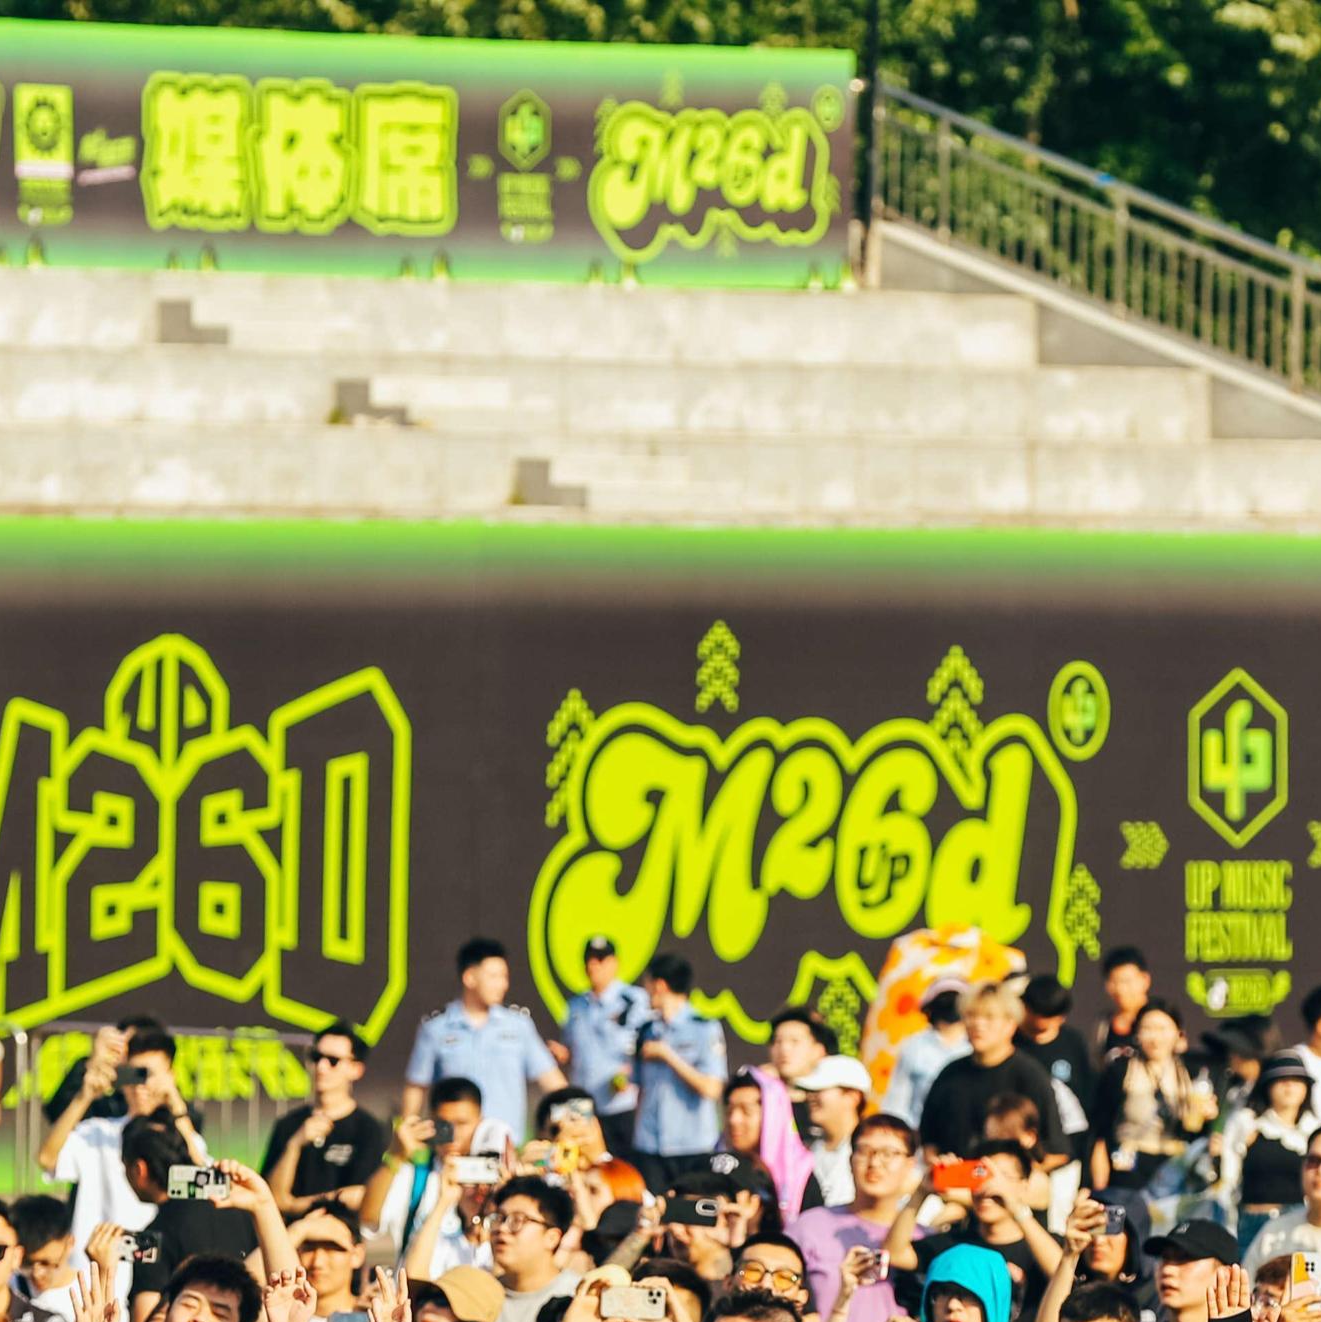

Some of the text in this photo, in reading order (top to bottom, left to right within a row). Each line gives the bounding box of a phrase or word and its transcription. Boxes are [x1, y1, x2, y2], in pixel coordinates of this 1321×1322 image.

[152, 79, 448, 228] 媒体席
[546, 732, 1034, 995] M26d
[1184, 859, 1293, 911] UP MUSIC
[1184, 910, 1294, 962] FESTIVAL
